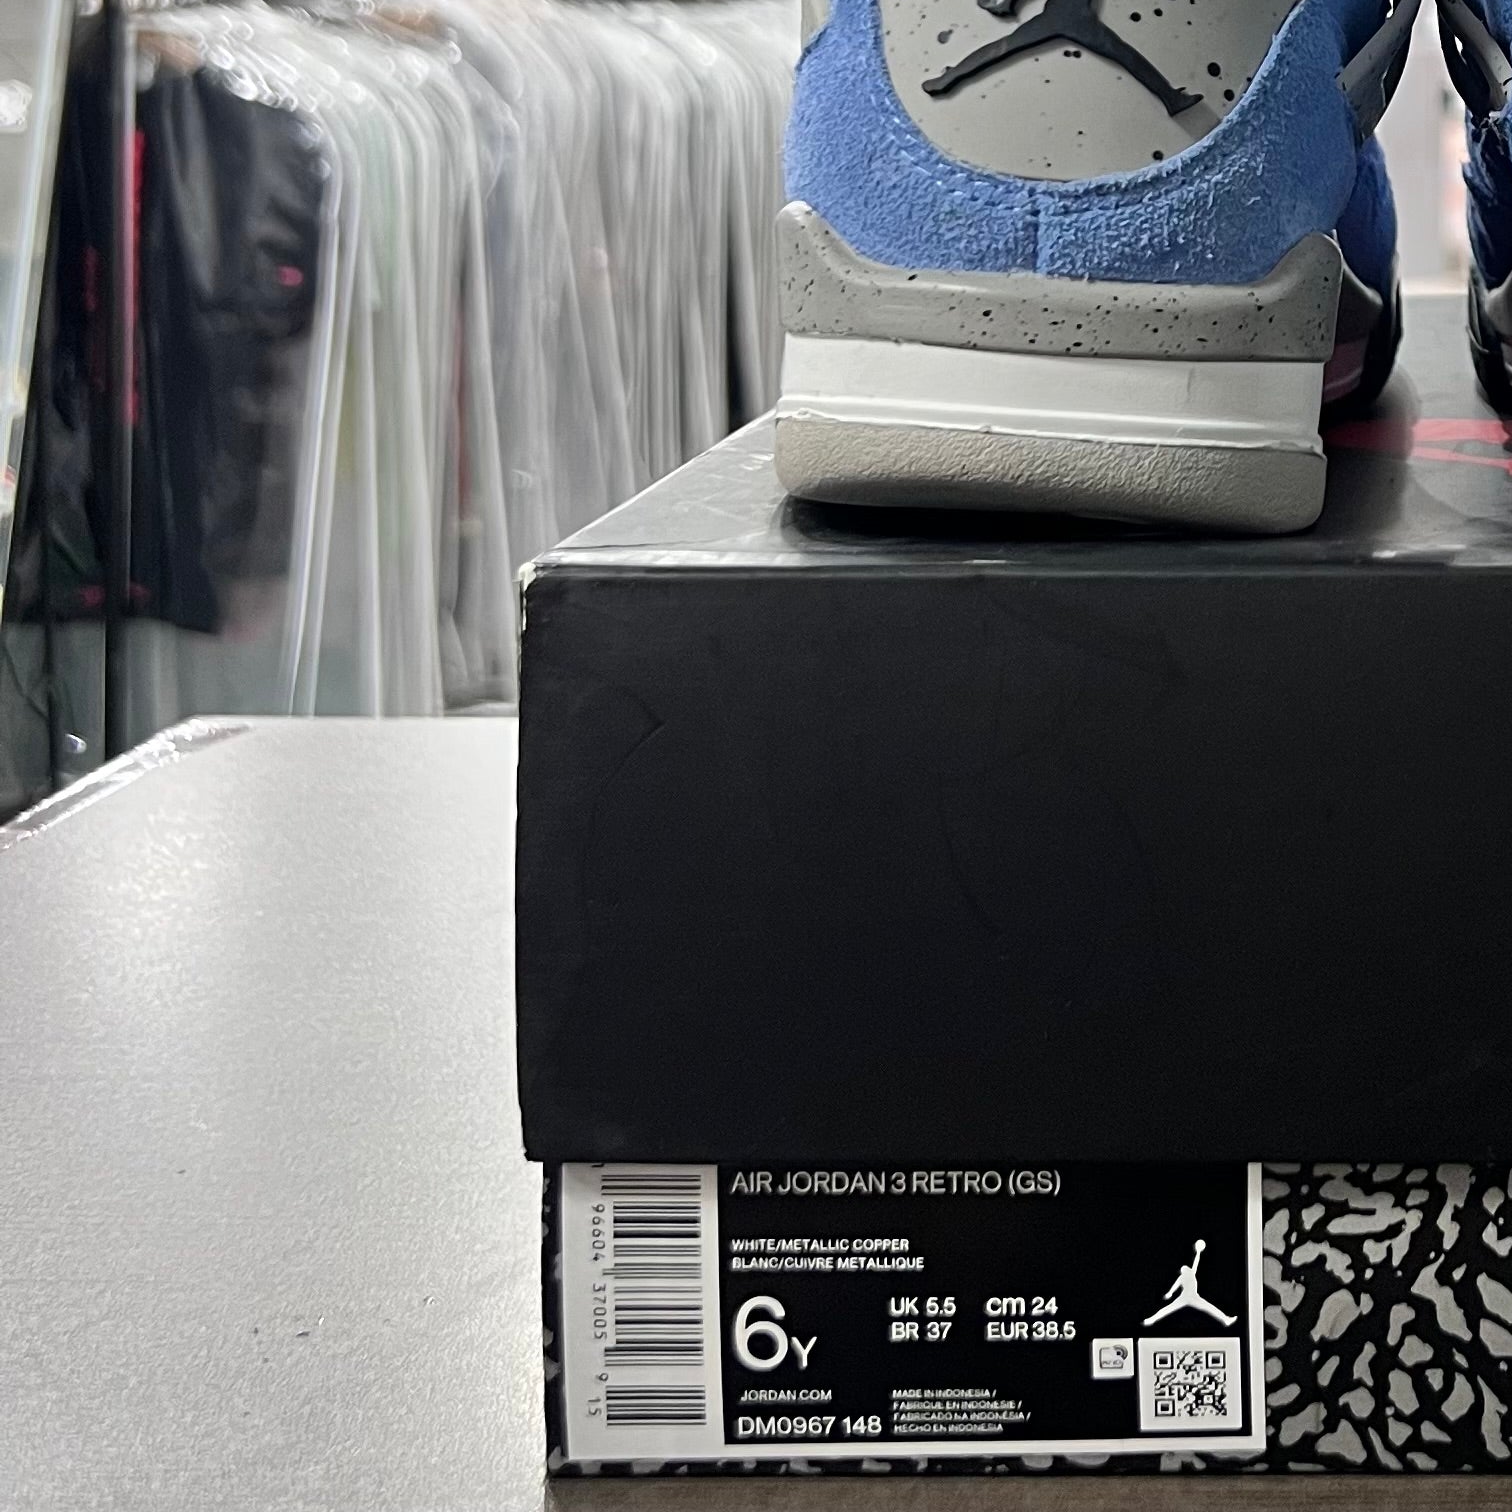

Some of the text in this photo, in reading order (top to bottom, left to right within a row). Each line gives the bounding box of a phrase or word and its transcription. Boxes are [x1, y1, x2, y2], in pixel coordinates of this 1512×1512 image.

[731, 1169, 1061, 1196] AIR JORDAN 3 RETRO (GS)
[591, 1203, 607, 1263] 96604
[731, 1238, 909, 1252] WHITE/METALLIC COPPER
[731, 1256, 924, 1270] BLANC/CUIVRE METALLIQUE
[591, 1283, 607, 1341] 37005
[889, 1296, 918, 1316] UK
[925, 1296, 956, 1316] 5.5
[1030, 1296, 1058, 1315] 24
[889, 1321, 1076, 1340] BR 37 EUR 38.5
[739, 1389, 832, 1403] JORDAN.COM
[892, 1388, 922, 1398] MADE
[738, 1415, 882, 1436] DM0967 148
